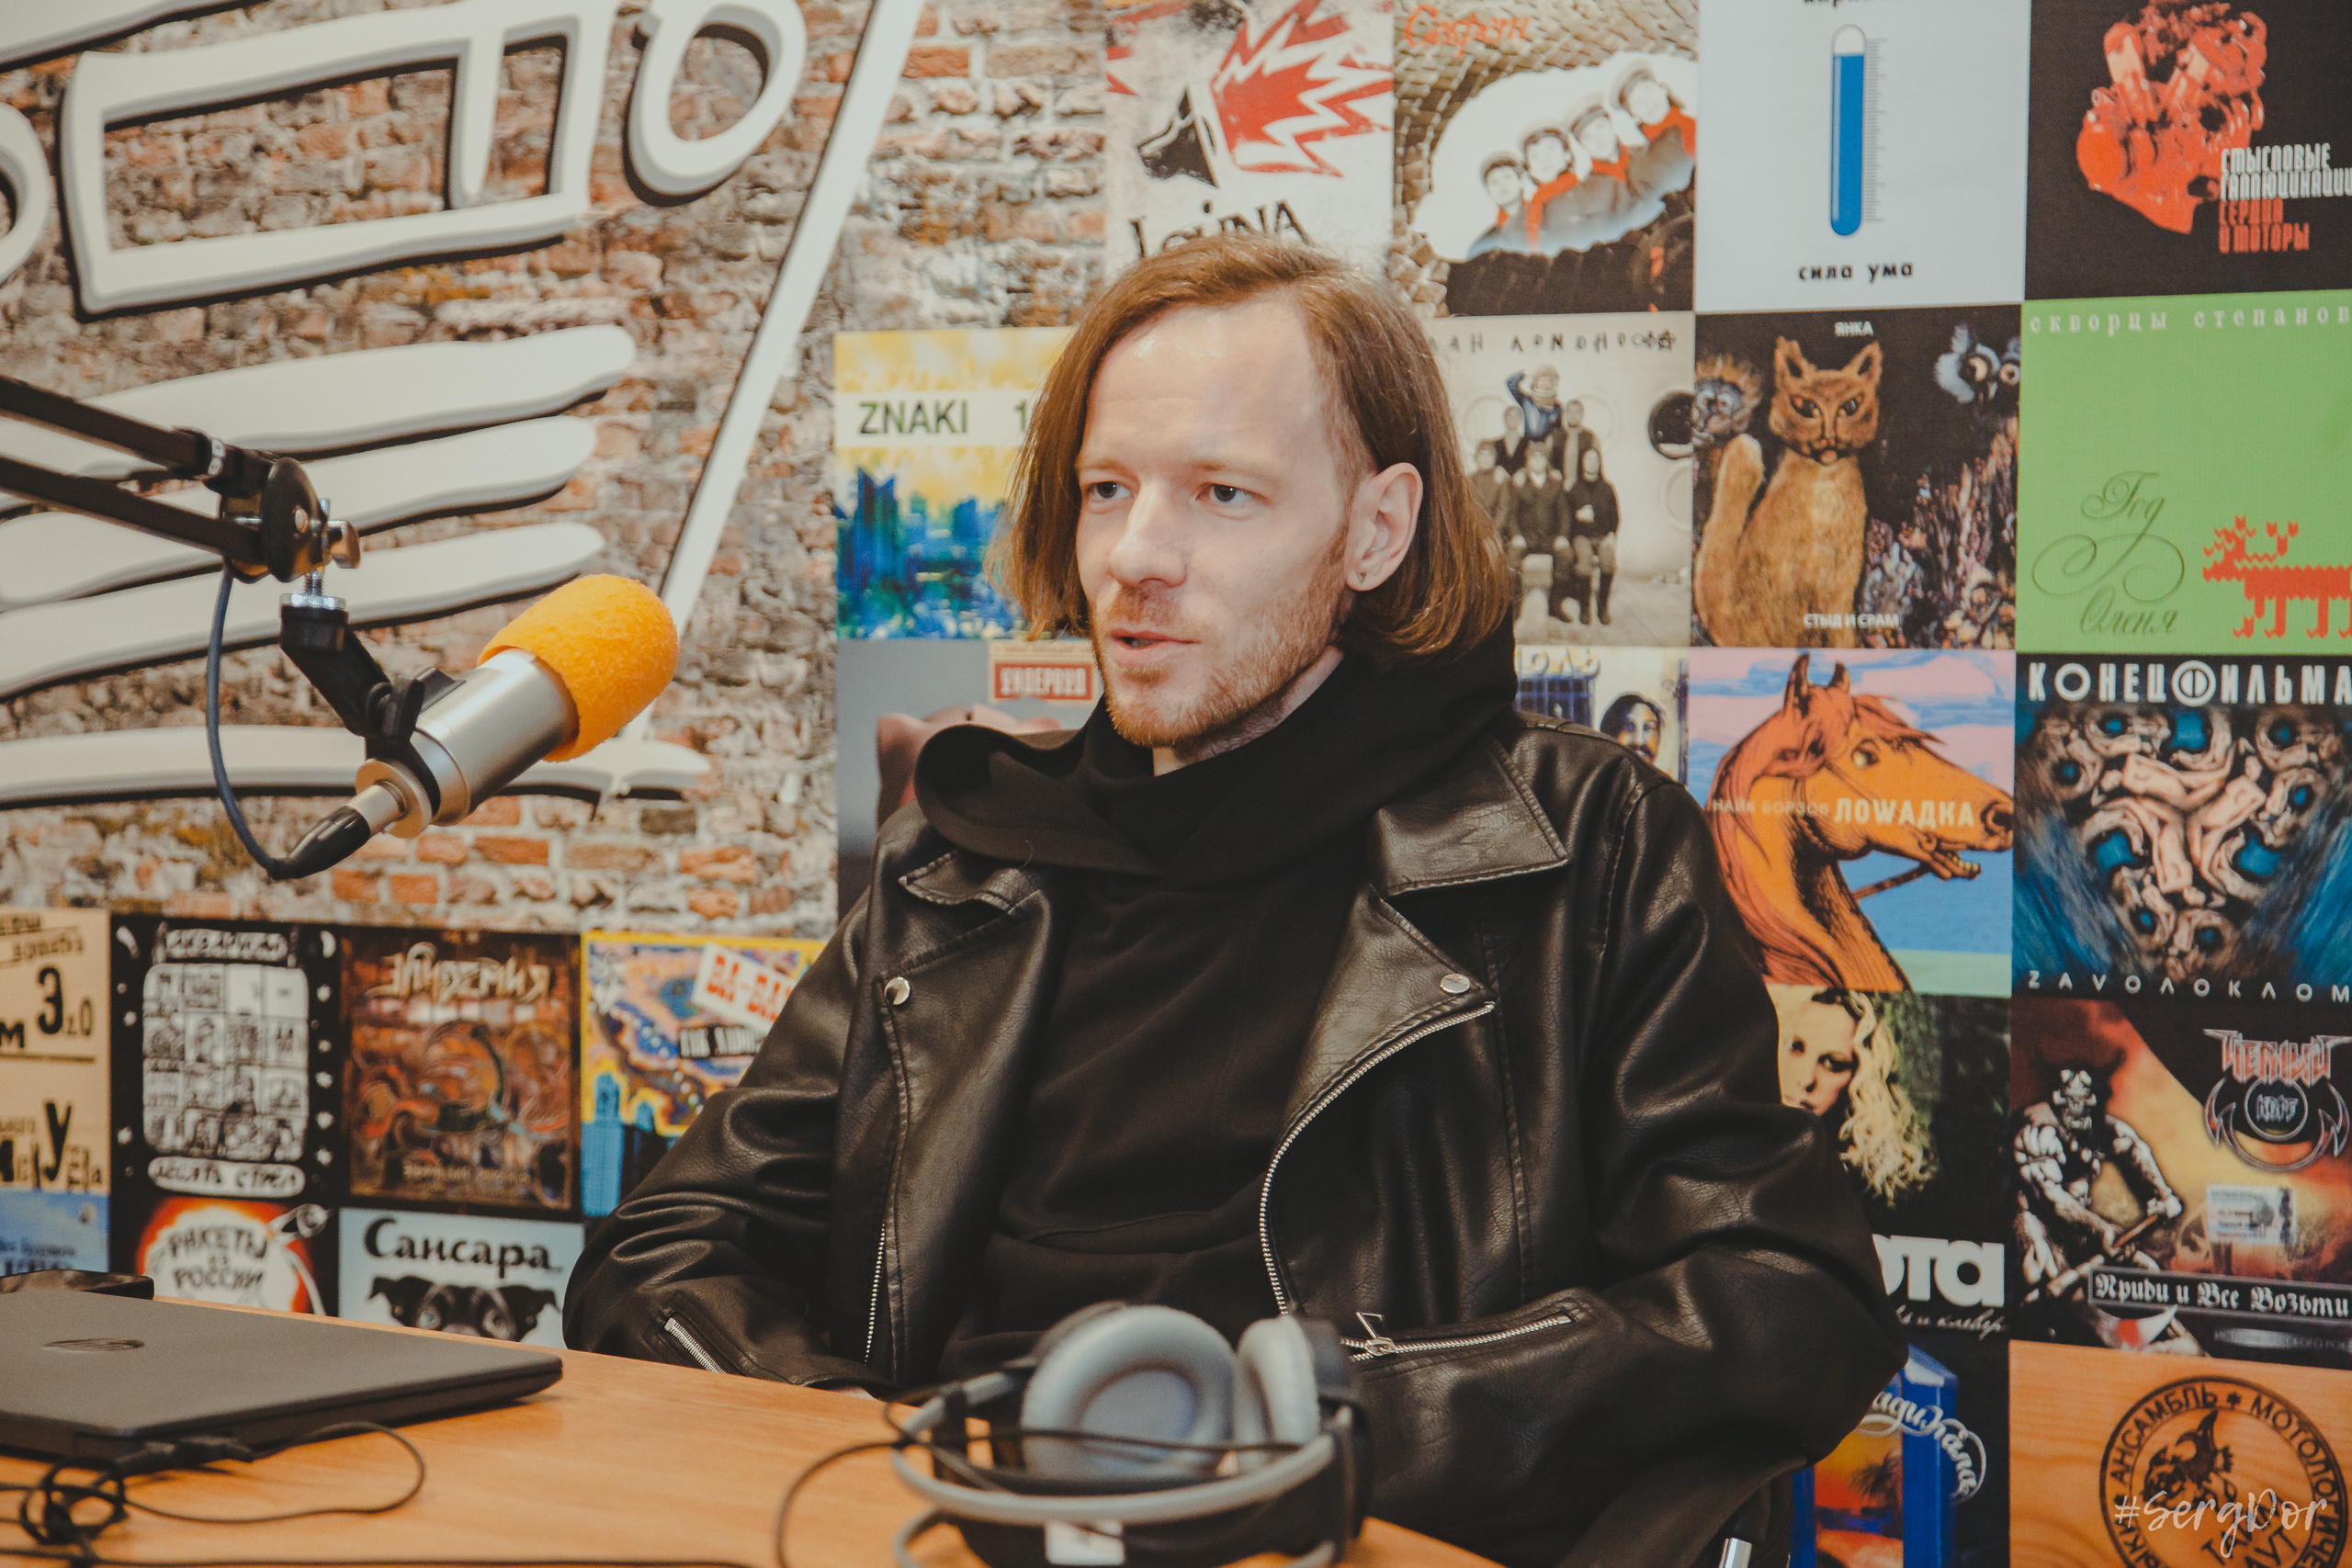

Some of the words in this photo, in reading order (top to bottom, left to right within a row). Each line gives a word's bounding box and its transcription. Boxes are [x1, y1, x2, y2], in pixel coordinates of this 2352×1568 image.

[2221, 142, 2331, 174] СМЫСЛОВЫЕ
[2233, 222, 2310, 254] МОТОРЫ
[1799, 265, 1853, 280] сила
[1868, 262, 1912, 283] ума
[1835, 321, 1874, 337] ЯНКА
[2030, 311, 2167, 336] скворцы
[858, 400, 968, 434] ZNAKI
[1803, 613, 1843, 629] СТЫД
[1858, 613, 1900, 628] СРАМ
[1514, 647, 1600, 677] ОЛЬ
[1762, 800, 1830, 817] БОРЗОВ
[168, 1227, 268, 1259] РАКЕТЫ
[364, 1216, 550, 1279] Сансара
[172, 1266, 264, 1290] РОССИИ
[2095, 1273, 2170, 1304] Приди
[2176, 1284, 2190, 1304] и
[2250, 1286, 2349, 1318] Возьми
[2109, 1384, 2219, 1486] АНСАМБЛЬ
